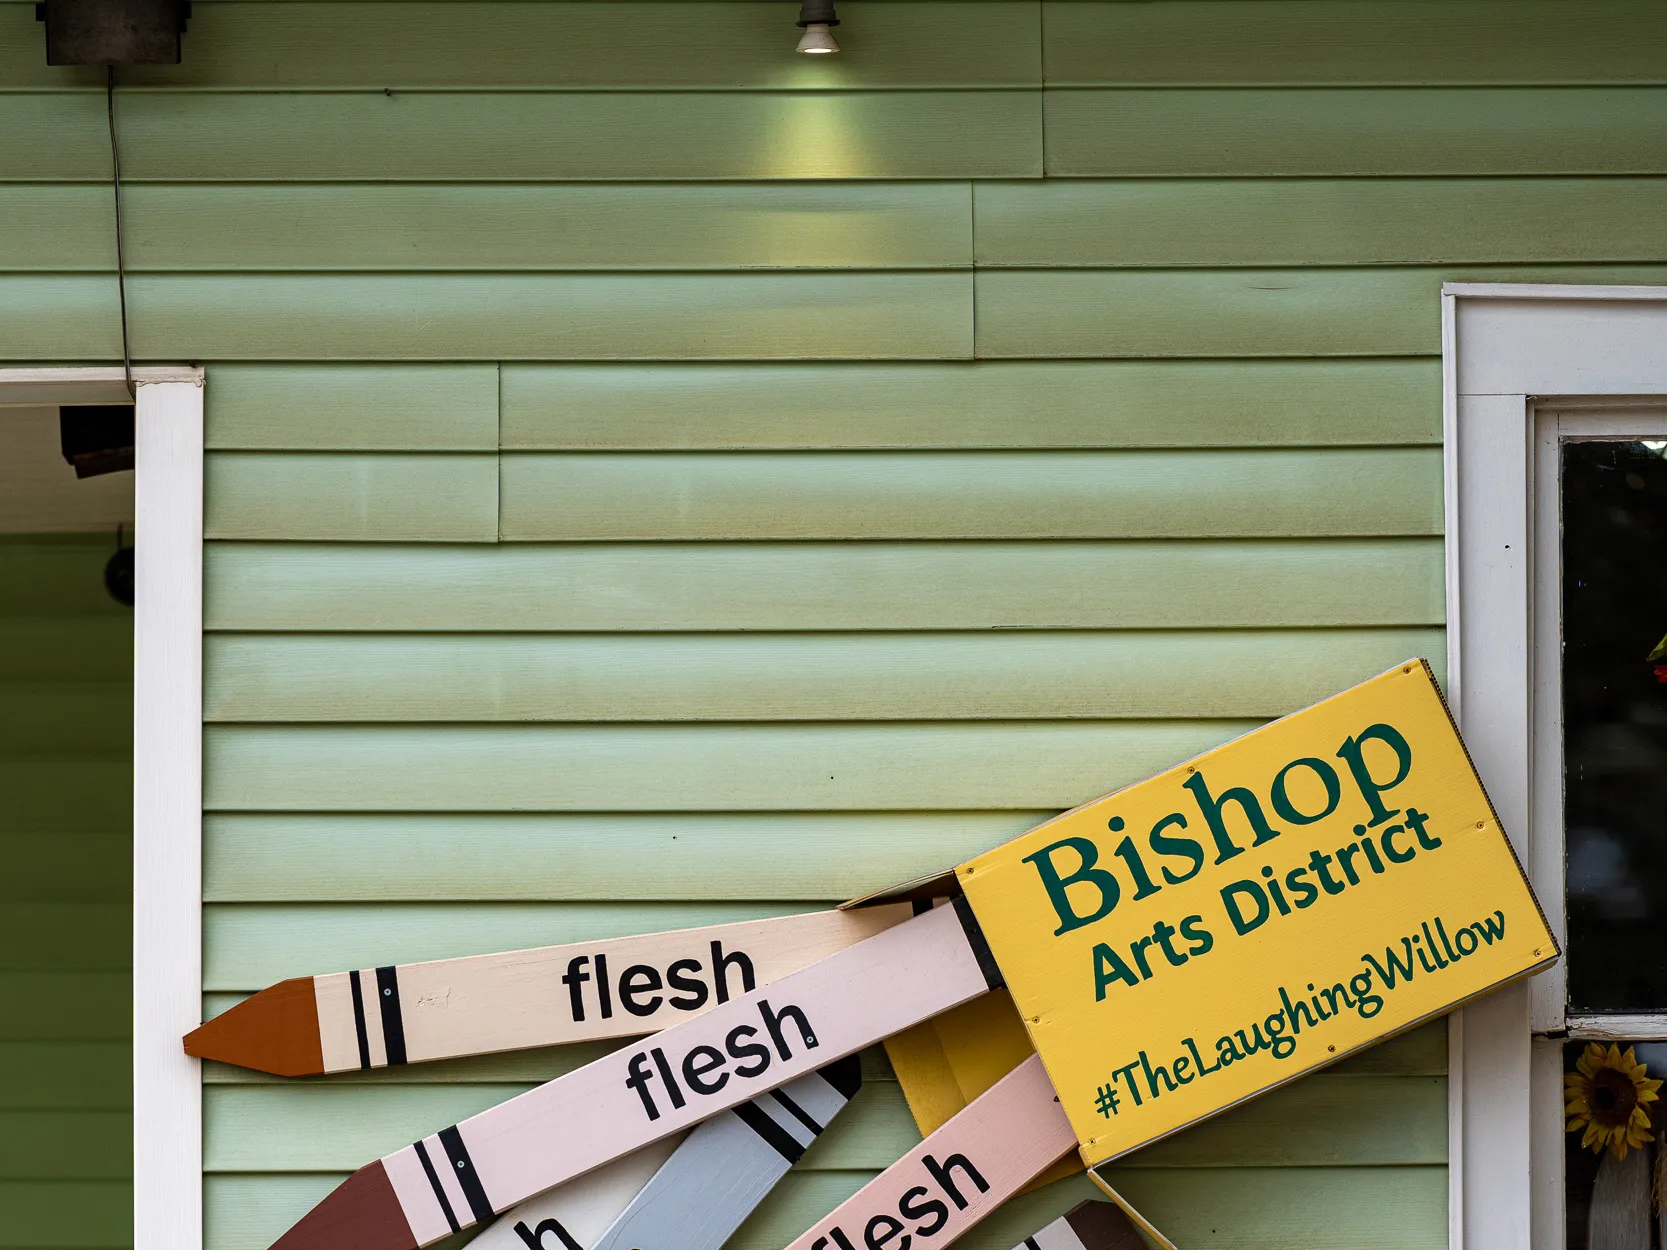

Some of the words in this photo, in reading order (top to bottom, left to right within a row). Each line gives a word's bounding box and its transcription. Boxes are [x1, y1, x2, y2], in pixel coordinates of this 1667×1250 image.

[1022, 723, 1412, 937] Bishop
[1092, 913, 1214, 1002] Arts
[1220, 808, 1442, 936] District
[562, 940, 756, 1021] flesh
[625, 1000, 819, 1121] flesh
[1094, 911, 1505, 1119] #TheLaughingWillow
